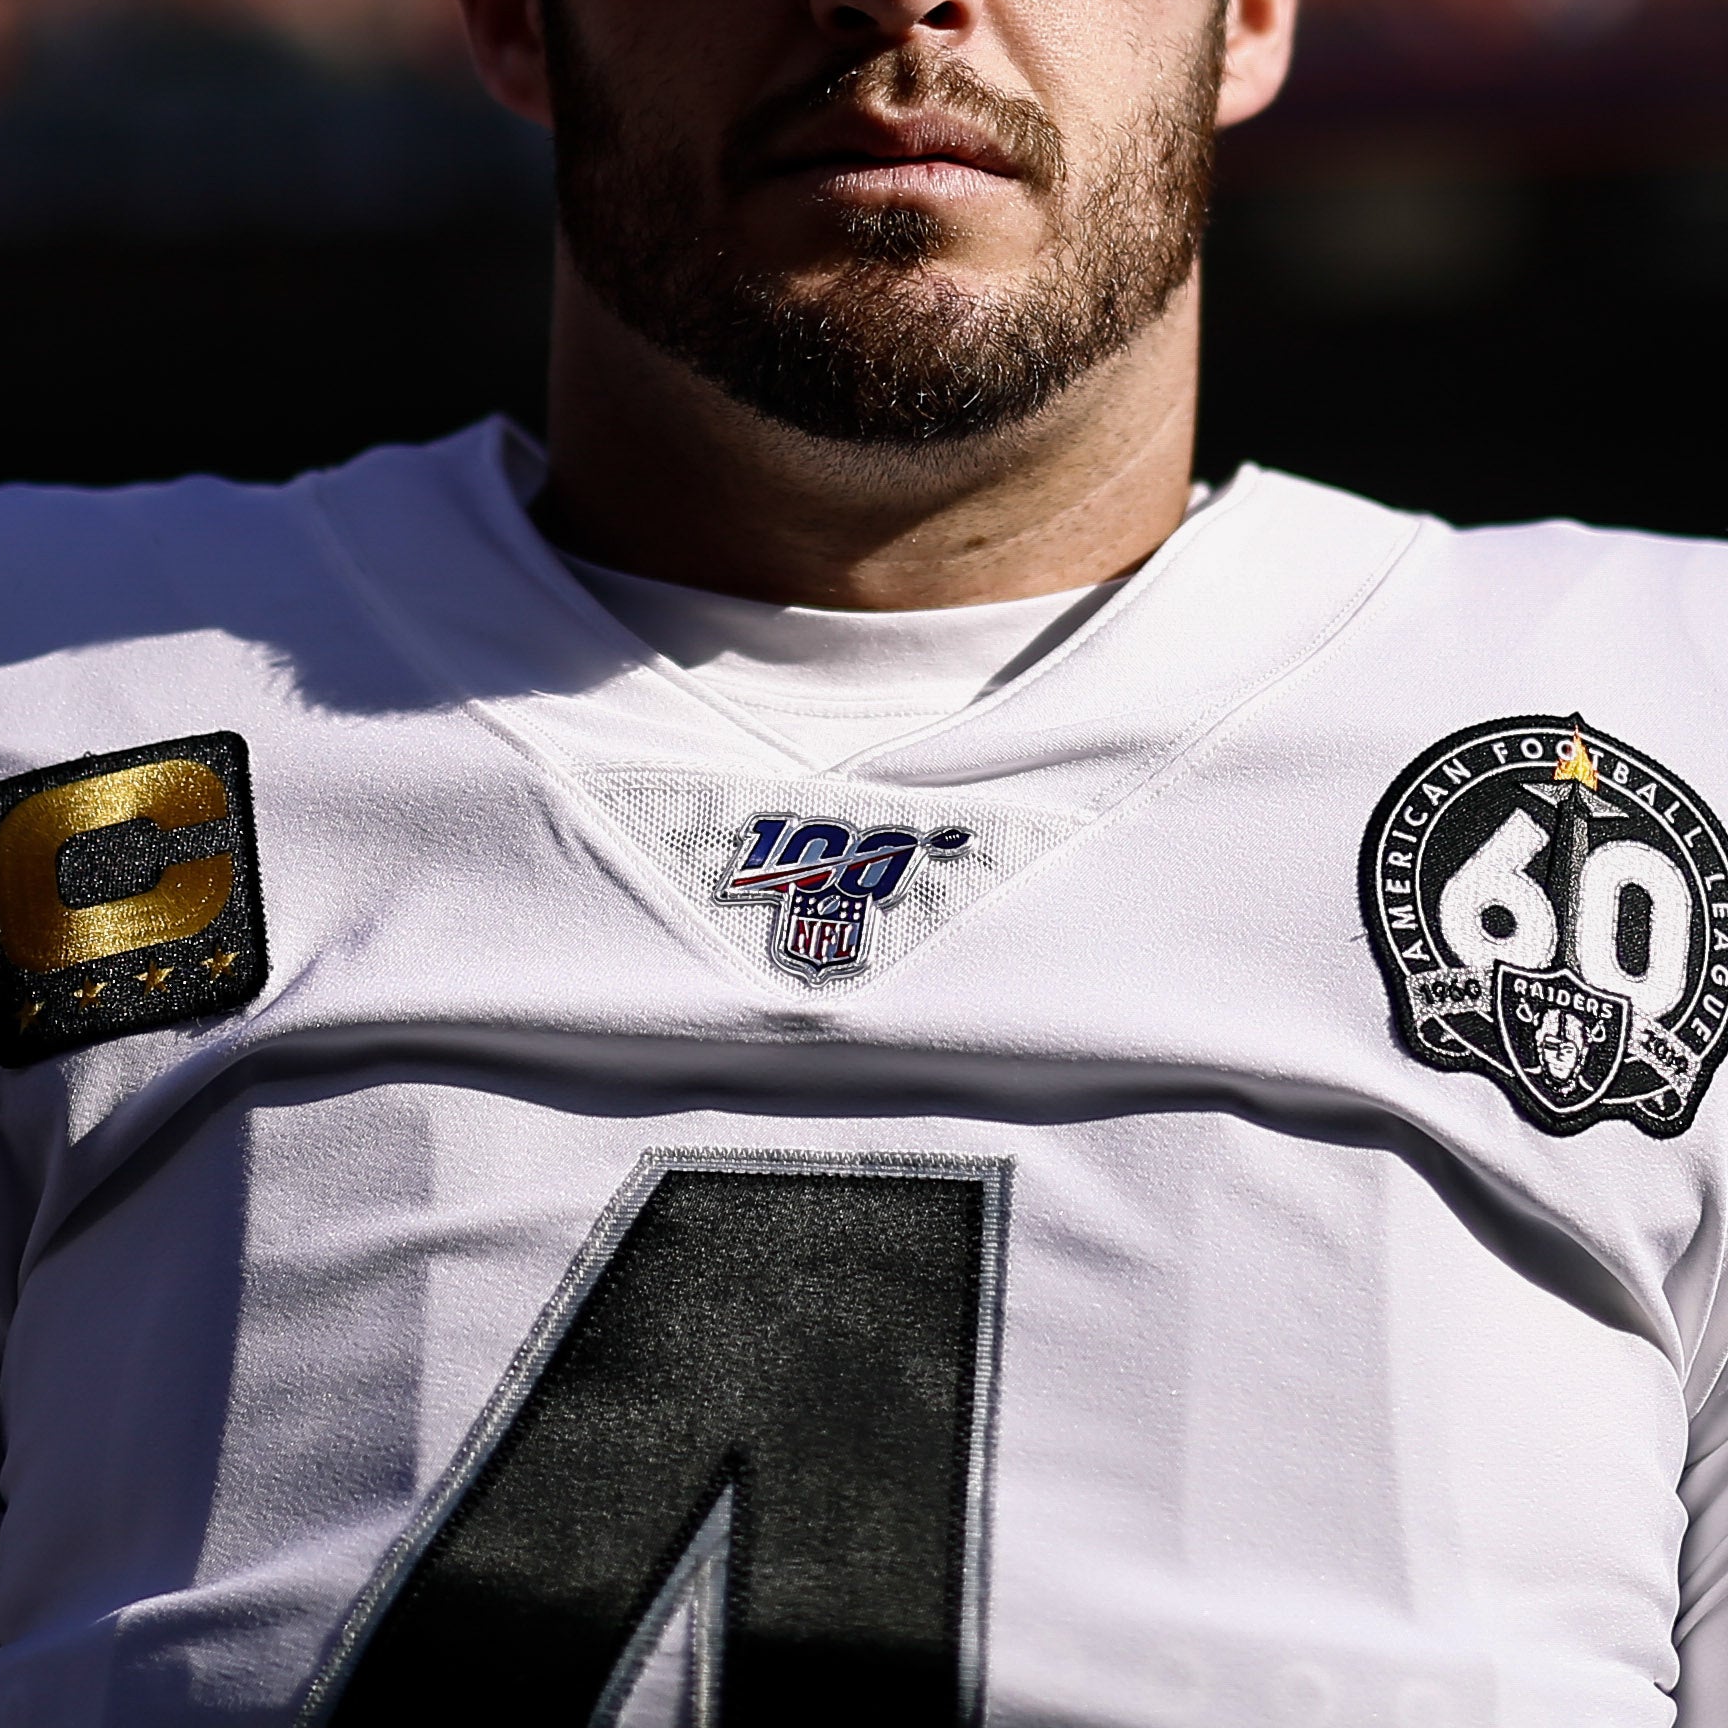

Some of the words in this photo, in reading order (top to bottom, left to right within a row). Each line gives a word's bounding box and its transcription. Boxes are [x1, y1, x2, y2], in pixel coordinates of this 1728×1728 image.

[733, 818, 920, 902] 100
[1385, 758, 1472, 962] AMERICAN
[1491, 737, 1704, 846] FOOTBALL
[790, 919, 858, 964] NFL
[1439, 808, 1691, 1015] 60
[1419, 978, 1482, 1005] 1960
[1513, 977, 1613, 1019] RAIDERS
[294, 1146, 1016, 1728] 4
